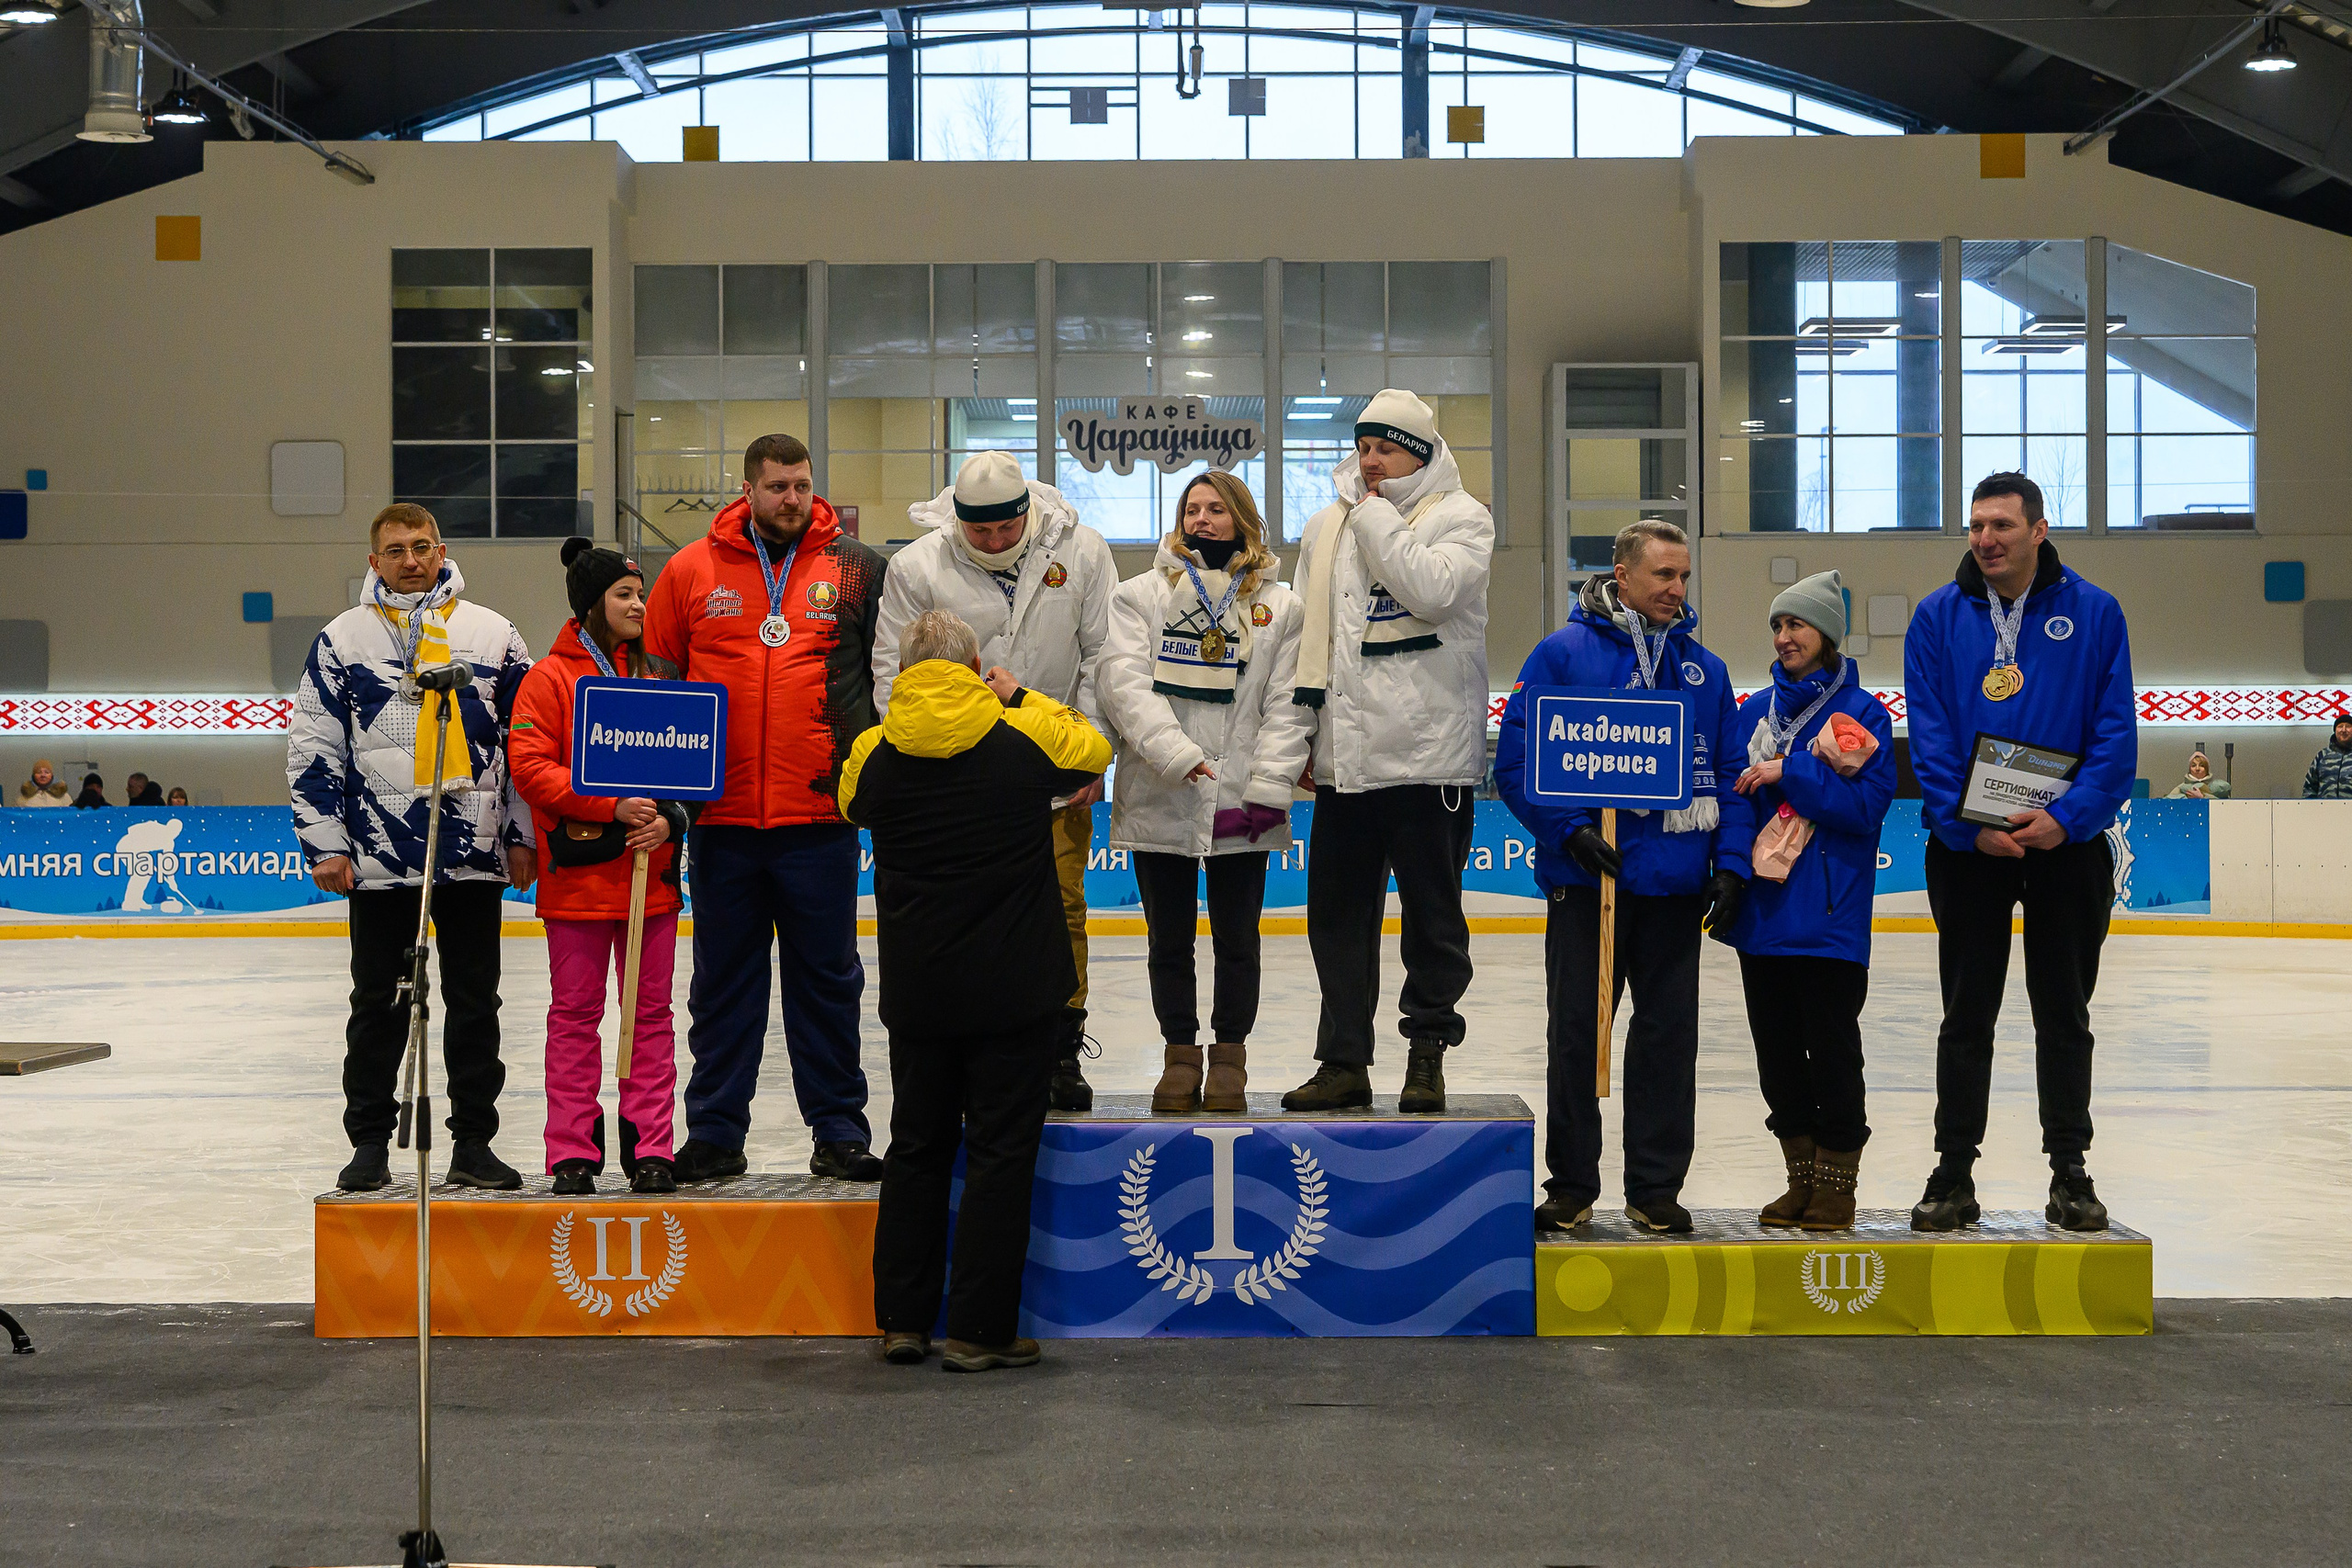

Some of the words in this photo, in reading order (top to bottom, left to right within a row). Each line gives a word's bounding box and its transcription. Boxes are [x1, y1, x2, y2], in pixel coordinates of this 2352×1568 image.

[1126, 405, 1196, 420] КАФЕ
[1067, 419, 1256, 467] Чараўніца
[1386, 430, 1429, 455] БЕЛАРУСЬ
[1161, 640, 1199, 657] БЕЛЫЕ
[590, 722, 709, 752] Агрохолдинг
[1547, 714, 1672, 745] Академия
[1562, 751, 1657, 780] сервиса
[1984, 778, 2056, 803] СЕРТИФИКАТ
[585, 1217, 651, 1280] II
